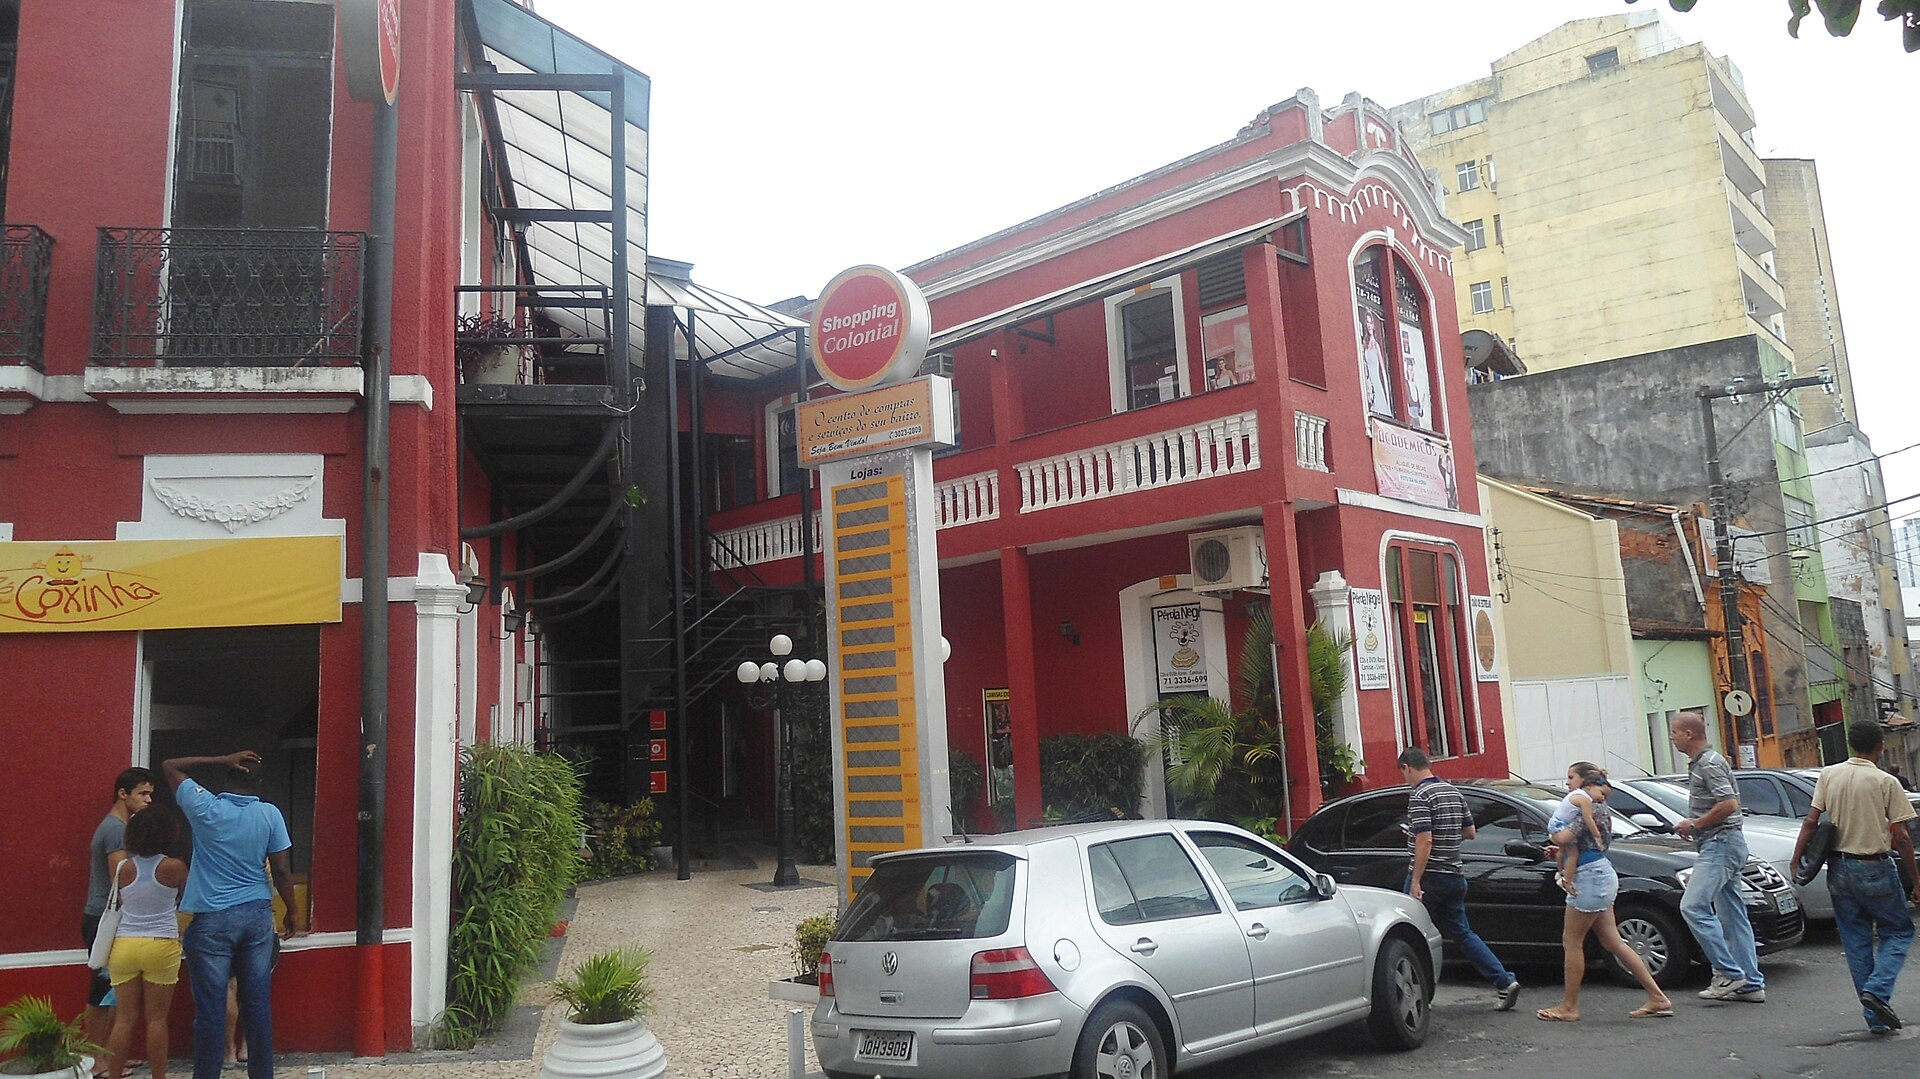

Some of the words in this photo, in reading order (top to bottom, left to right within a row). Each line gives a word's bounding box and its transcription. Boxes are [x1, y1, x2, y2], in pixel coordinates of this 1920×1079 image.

[822, 301, 897, 333] Shopping
[823, 319, 899, 354] Colonial
[814, 410, 825, 427] O
[827, 409, 856, 424] centro
[859, 404, 870, 417] de
[874, 397, 915, 415] compras
[817, 425, 853, 440] serviços
[856, 419, 867, 432] do
[870, 417, 887, 429] seu
[810, 445, 826, 456] Seja
[828, 443, 843, 451] Bem
[845, 435, 869, 448] Vindo!
[850, 467, 883, 480] Lojas:
[15, 572, 161, 619] Coxinha
[1157, 608, 1181, 621] Pérola
[1163, 677, 1172, 685] 71
[1174, 674, 1208, 685] 3336-699
